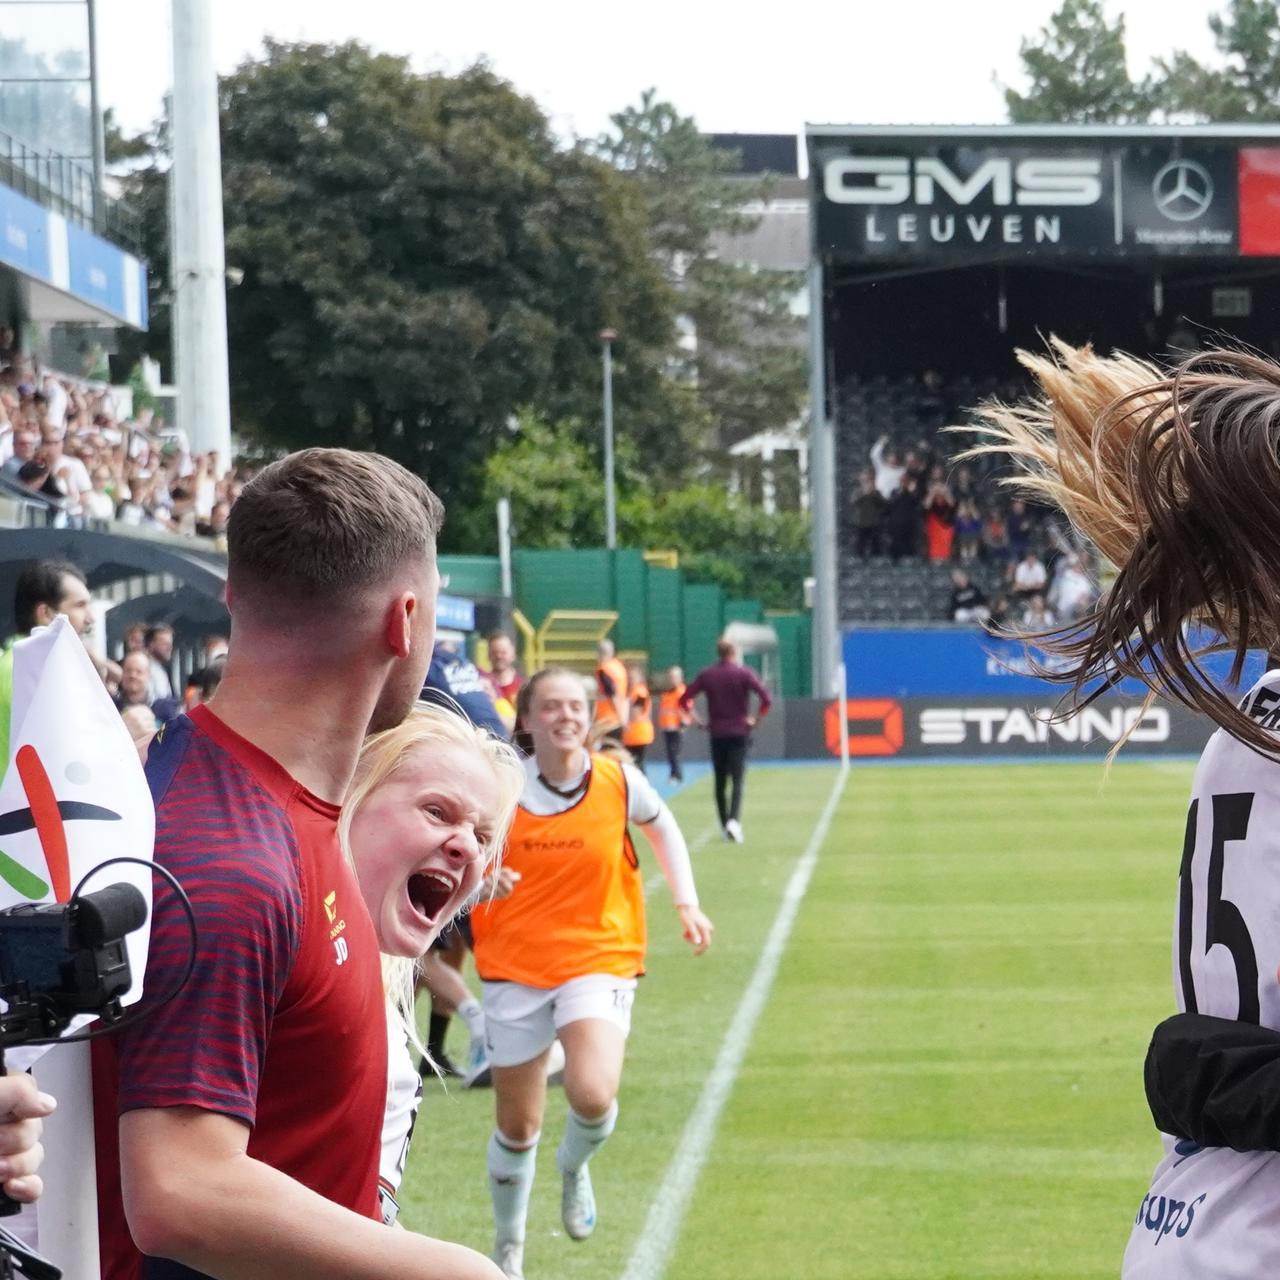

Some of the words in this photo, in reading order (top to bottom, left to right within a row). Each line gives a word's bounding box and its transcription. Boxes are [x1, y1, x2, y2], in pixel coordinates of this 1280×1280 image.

[823, 157, 1102, 207] GMS
[866, 216, 1061, 244] LEUVEN
[920, 707, 1170, 744] STANNO
[333, 936, 349, 966] JD
